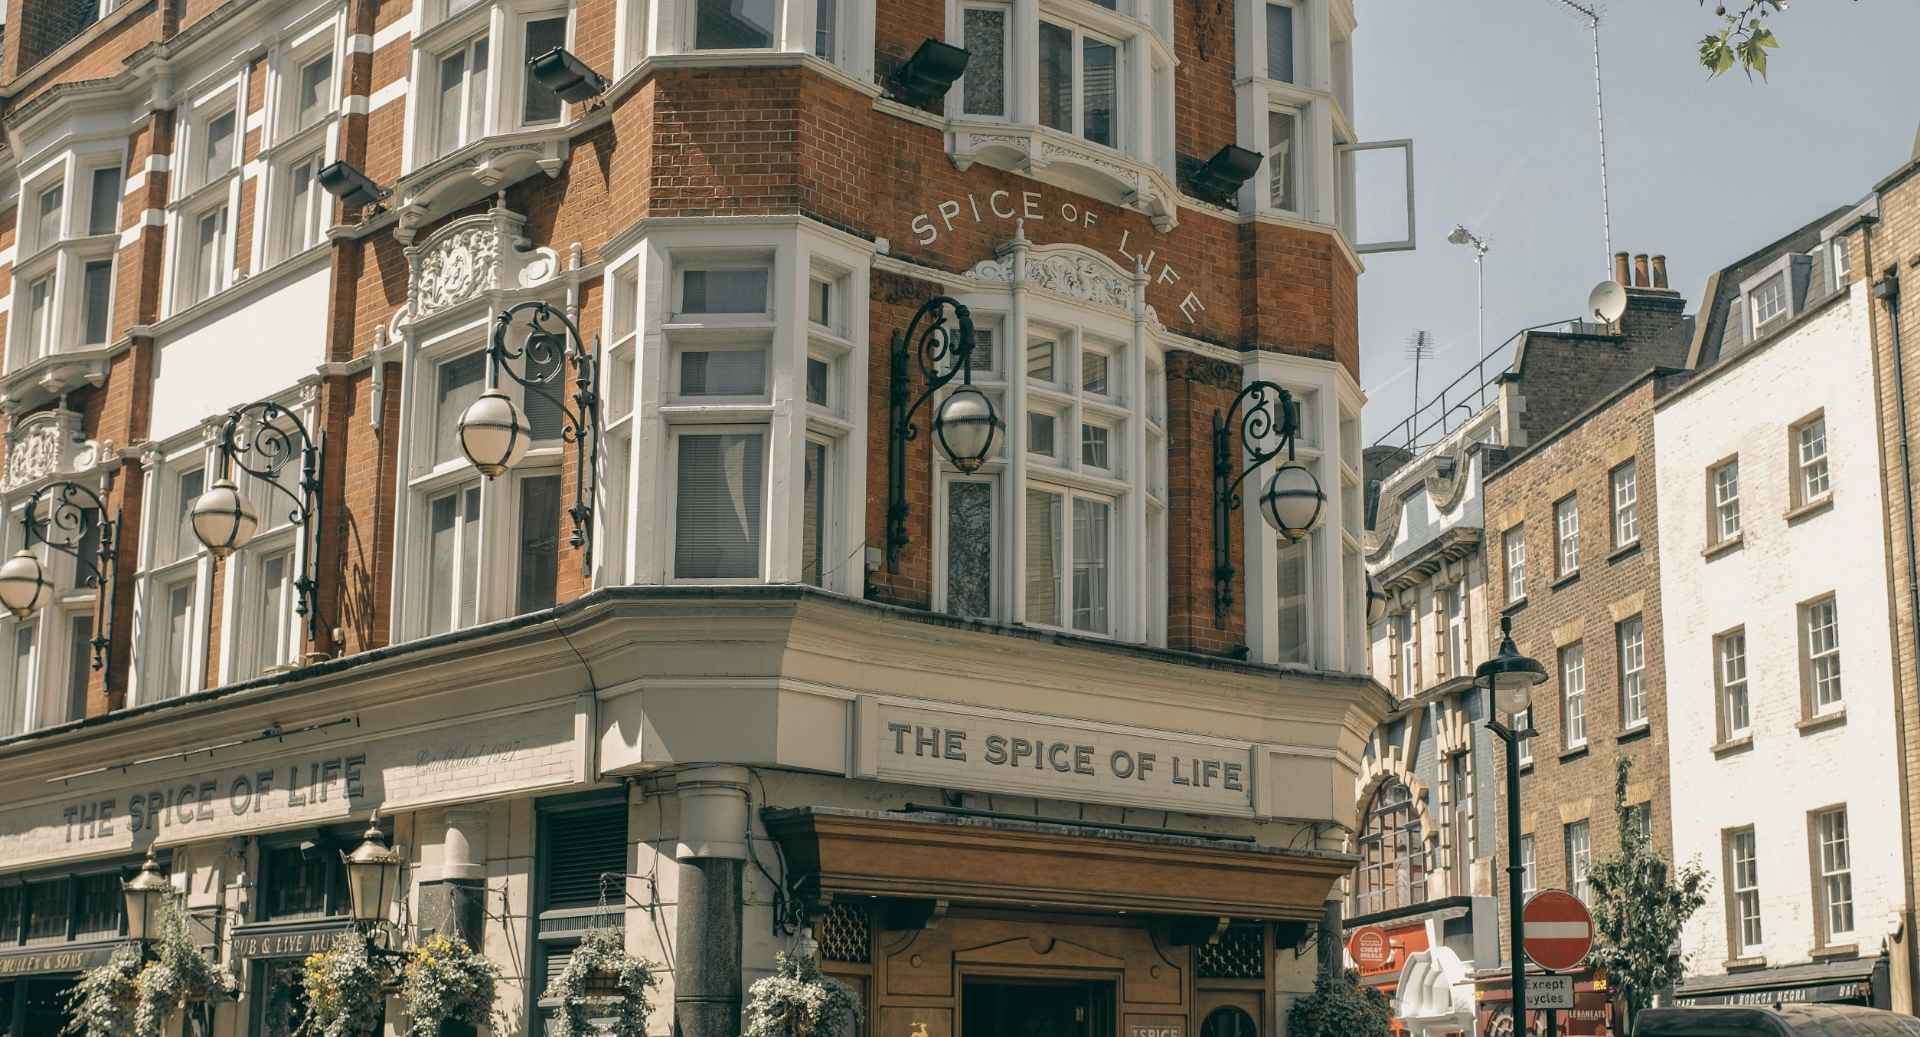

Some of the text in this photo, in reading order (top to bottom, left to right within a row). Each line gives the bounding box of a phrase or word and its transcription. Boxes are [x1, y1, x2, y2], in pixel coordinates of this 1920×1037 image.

[911, 190, 1206, 324] SPICE OF LIFE
[887, 721, 1243, 793] THE SPICE OF LIFE
[63, 752, 367, 843] THE SPICE OF LIFE
[54, 952, 84, 969] SONS
[233, 938, 257, 955] PUB
[261, 936, 271, 954] &
[276, 935, 304, 953] LIVE
[1738, 991, 1772, 1006] BODEGA
[1777, 989, 1806, 1002] NEGRA
